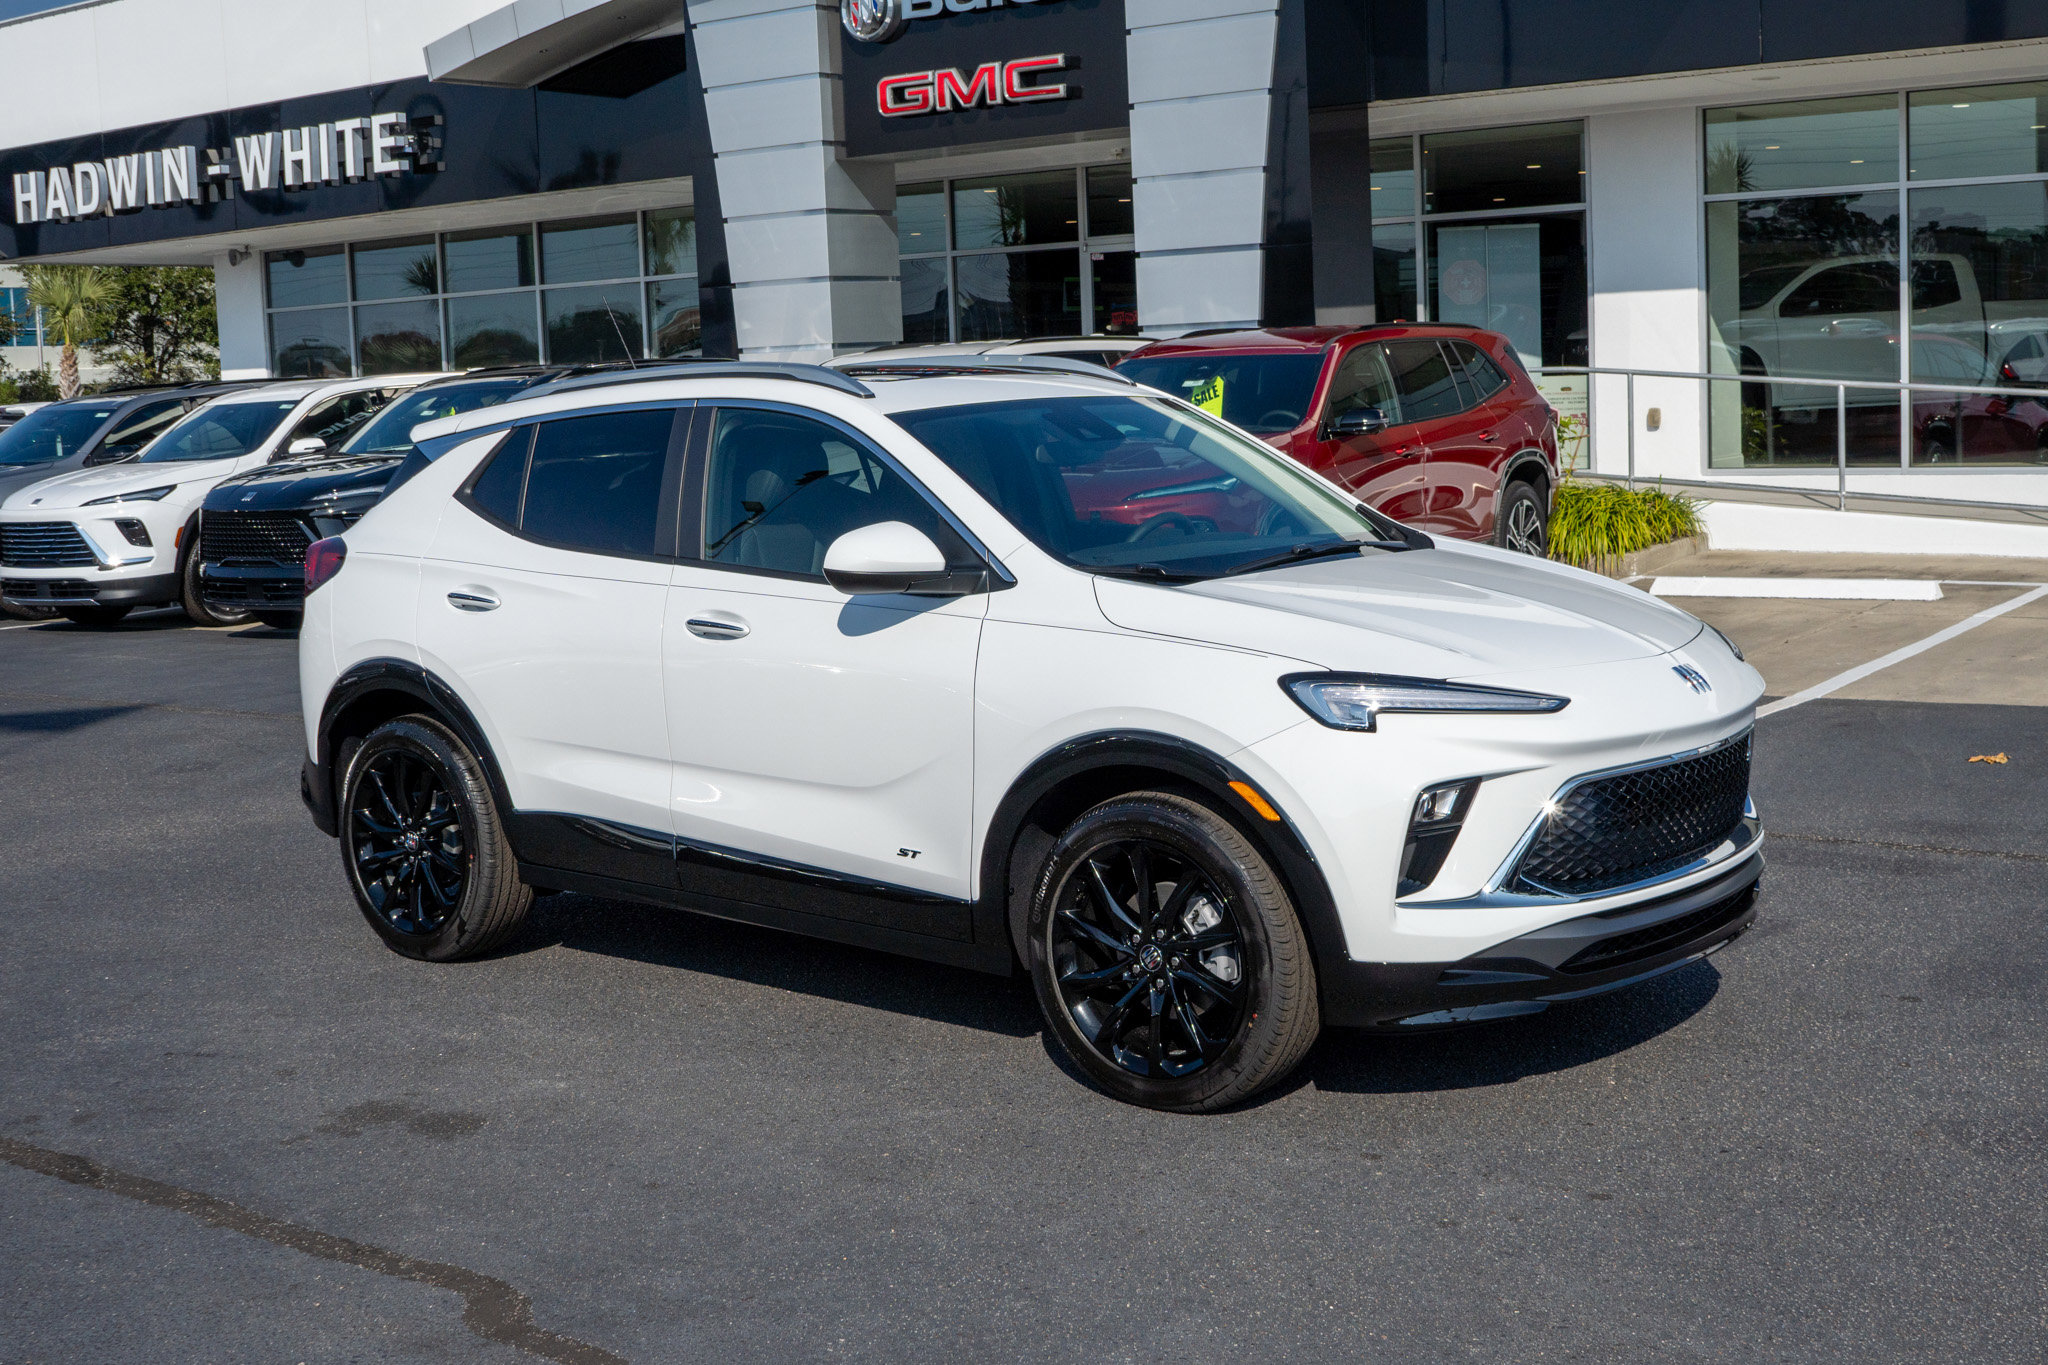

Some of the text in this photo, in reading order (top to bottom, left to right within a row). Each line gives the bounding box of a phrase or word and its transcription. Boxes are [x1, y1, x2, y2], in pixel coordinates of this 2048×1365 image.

[876, 53, 1067, 118] GMC
[1194, 384, 1220, 406] SALE
[896, 847, 922, 859] ST
